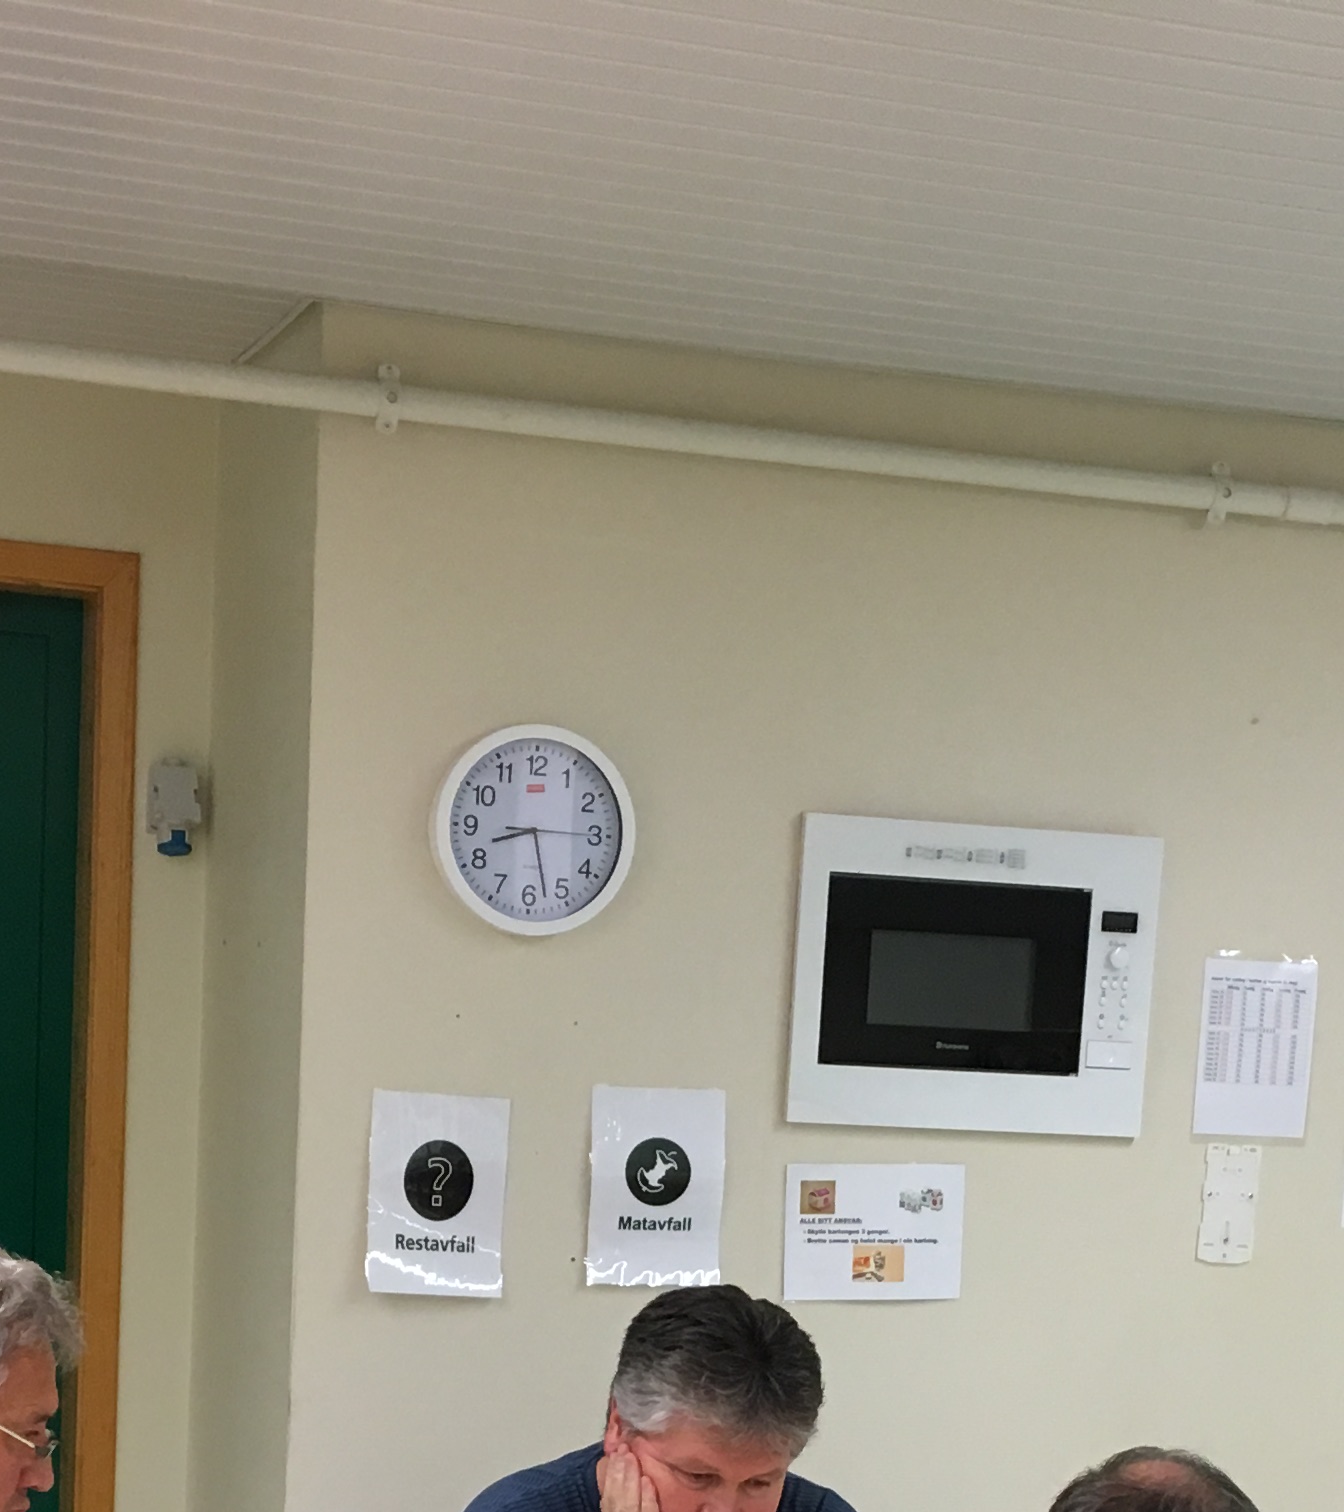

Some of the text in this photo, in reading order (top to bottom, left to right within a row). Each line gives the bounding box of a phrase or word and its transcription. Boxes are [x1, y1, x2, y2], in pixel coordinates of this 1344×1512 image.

[495, 762, 513, 783] 11
[526, 755, 548, 776] 12
[562, 768, 570, 789] 1
[473, 785, 496, 807] 10
[581, 792, 596, 813] 2
[463, 814, 478, 836] 9
[587, 825, 602, 846] 3
[471, 848, 487, 869] 8
[578, 858, 592, 879] 4
[494, 873, 508, 894] 7
[555, 878, 569, 900] 5
[521, 884, 536, 906] 6
[618, 1216, 692, 1231] Matavfall
[395, 1233, 475, 1253] Restavfall
